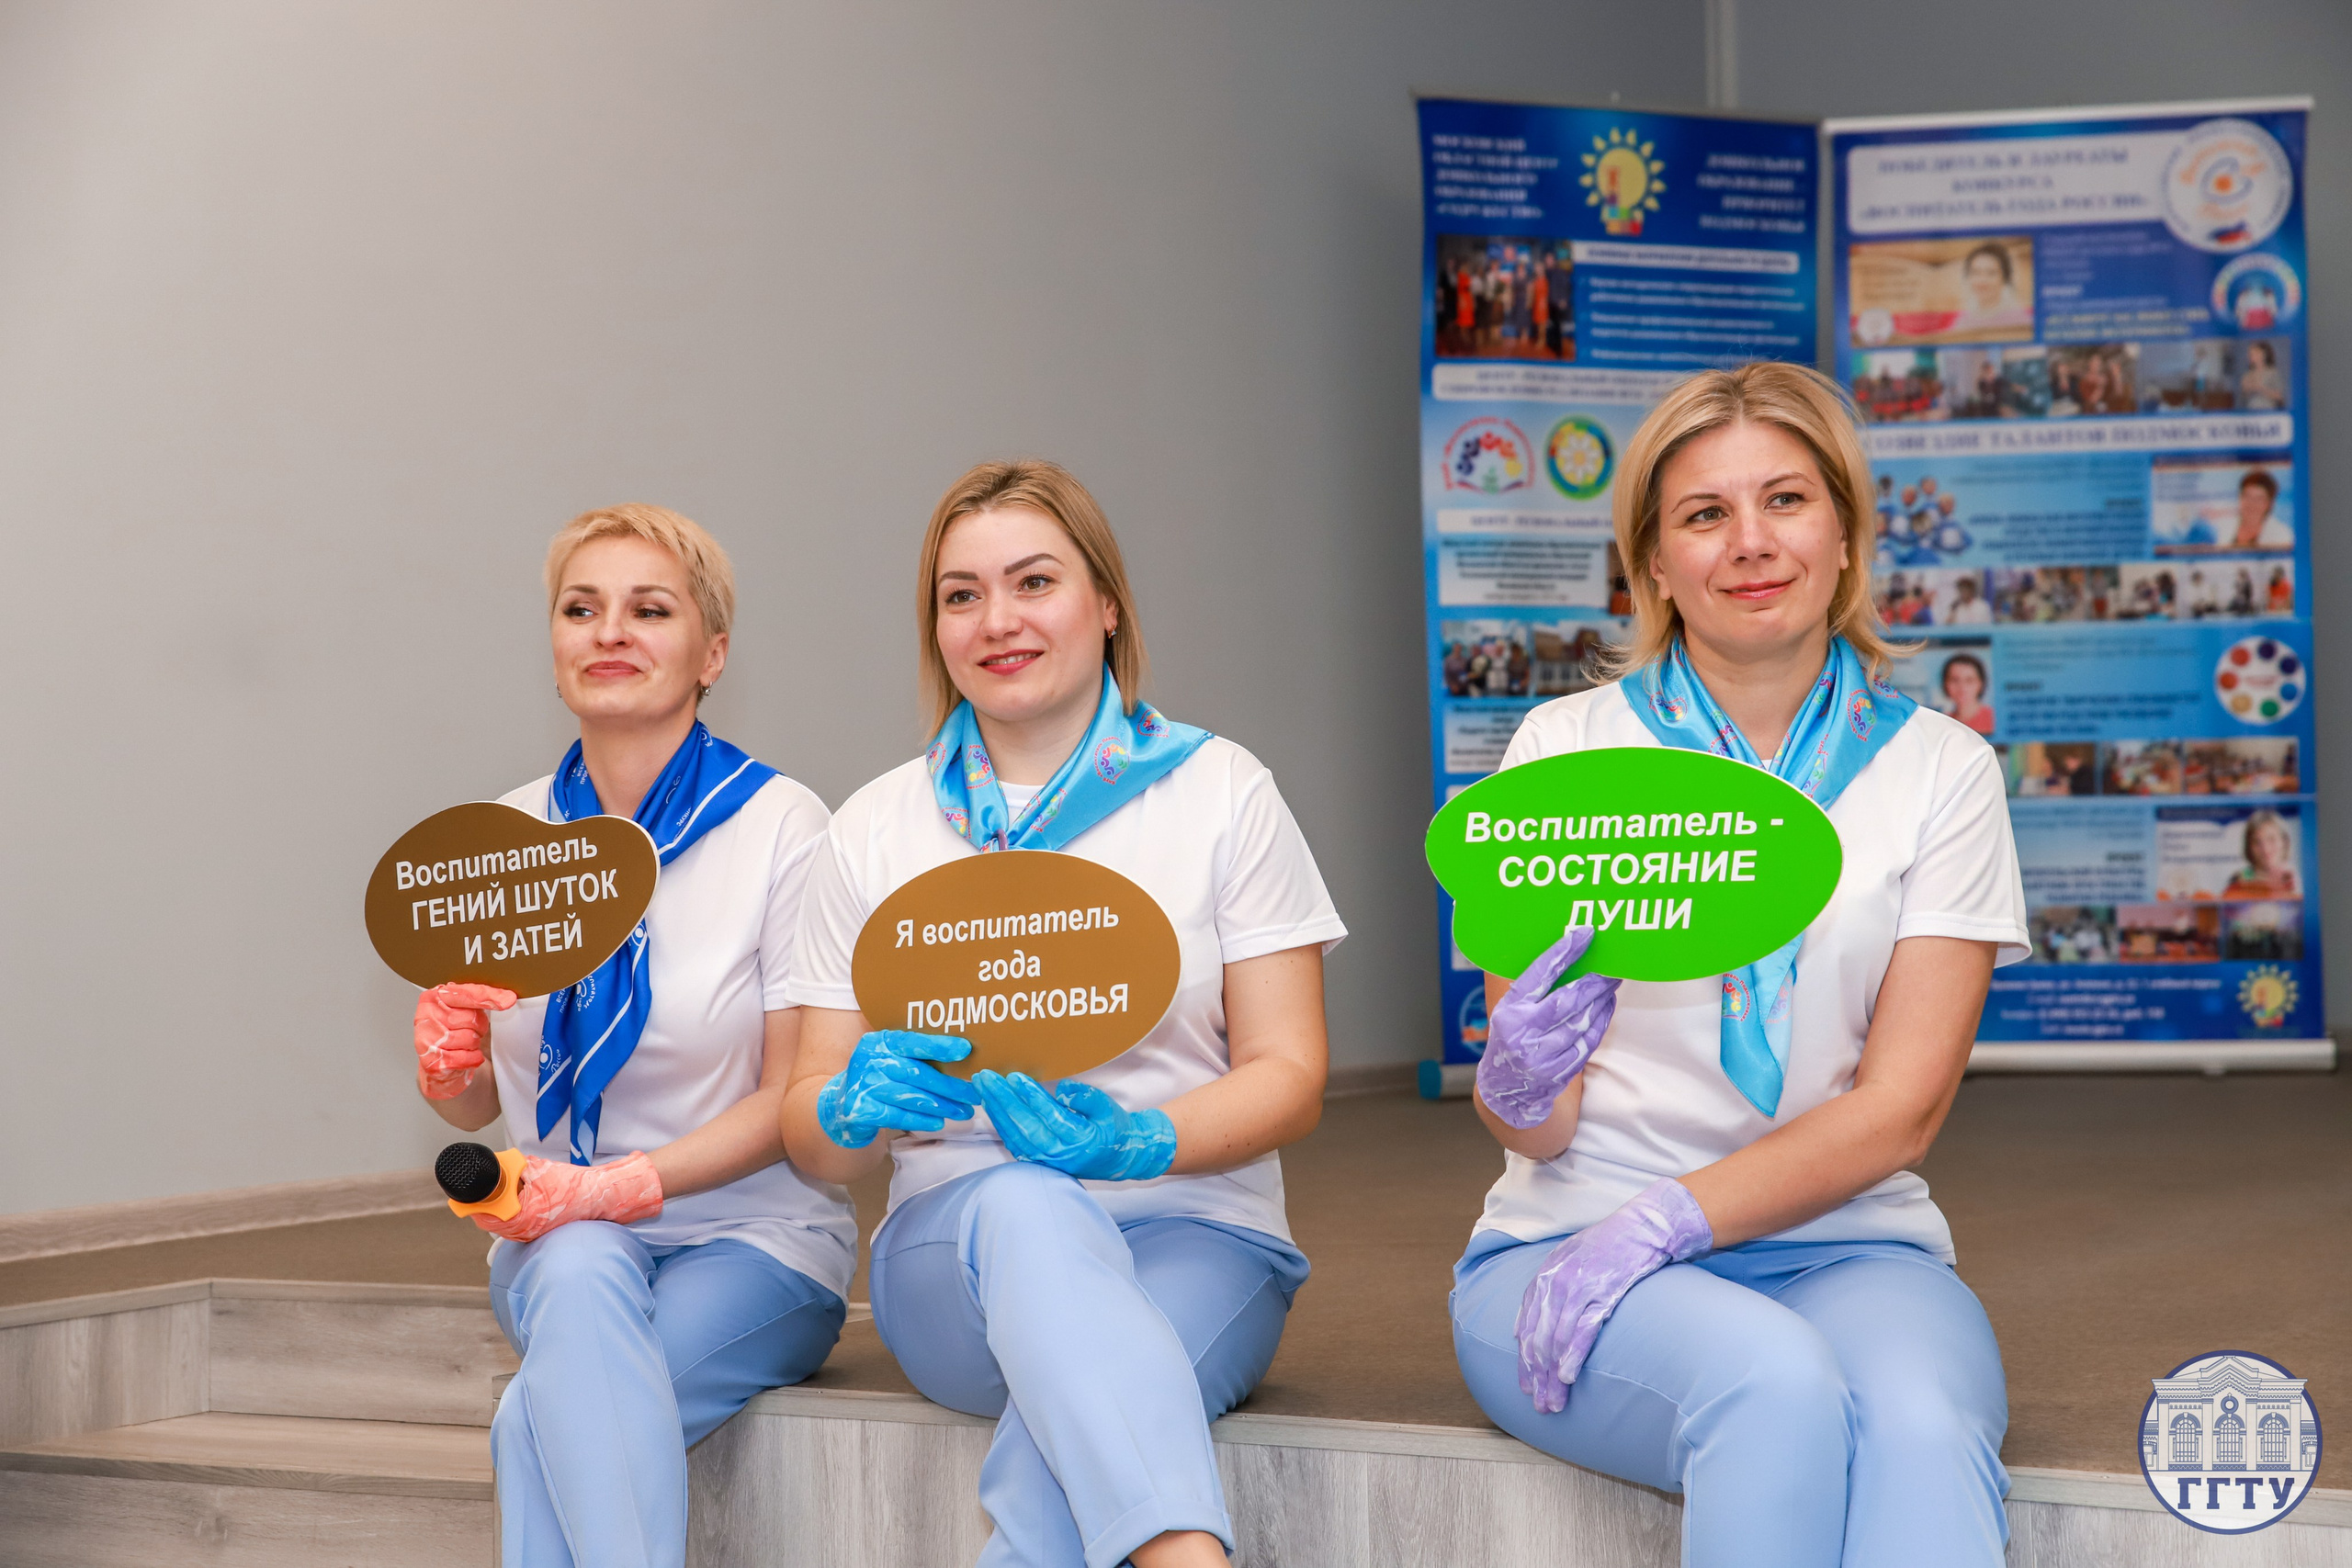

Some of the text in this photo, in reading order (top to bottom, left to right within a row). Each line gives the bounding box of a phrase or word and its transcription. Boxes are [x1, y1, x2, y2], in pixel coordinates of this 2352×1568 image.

[1464, 811, 1758, 843] Воспитатель
[396, 837, 598, 891] Воспитатель
[1498, 850, 1758, 887] СОСТОЯНИЕ
[412, 868, 619, 931] ГЕНИЙ ШУТОК
[1564, 897, 1693, 935] ДУШИ
[464, 912, 582, 965] И ЗАТЕЙ
[895, 906, 1120, 949] Я воспитатель
[978, 949, 1041, 982] года
[907, 983, 1129, 1033] ПОДМОСКОВЬЯ
